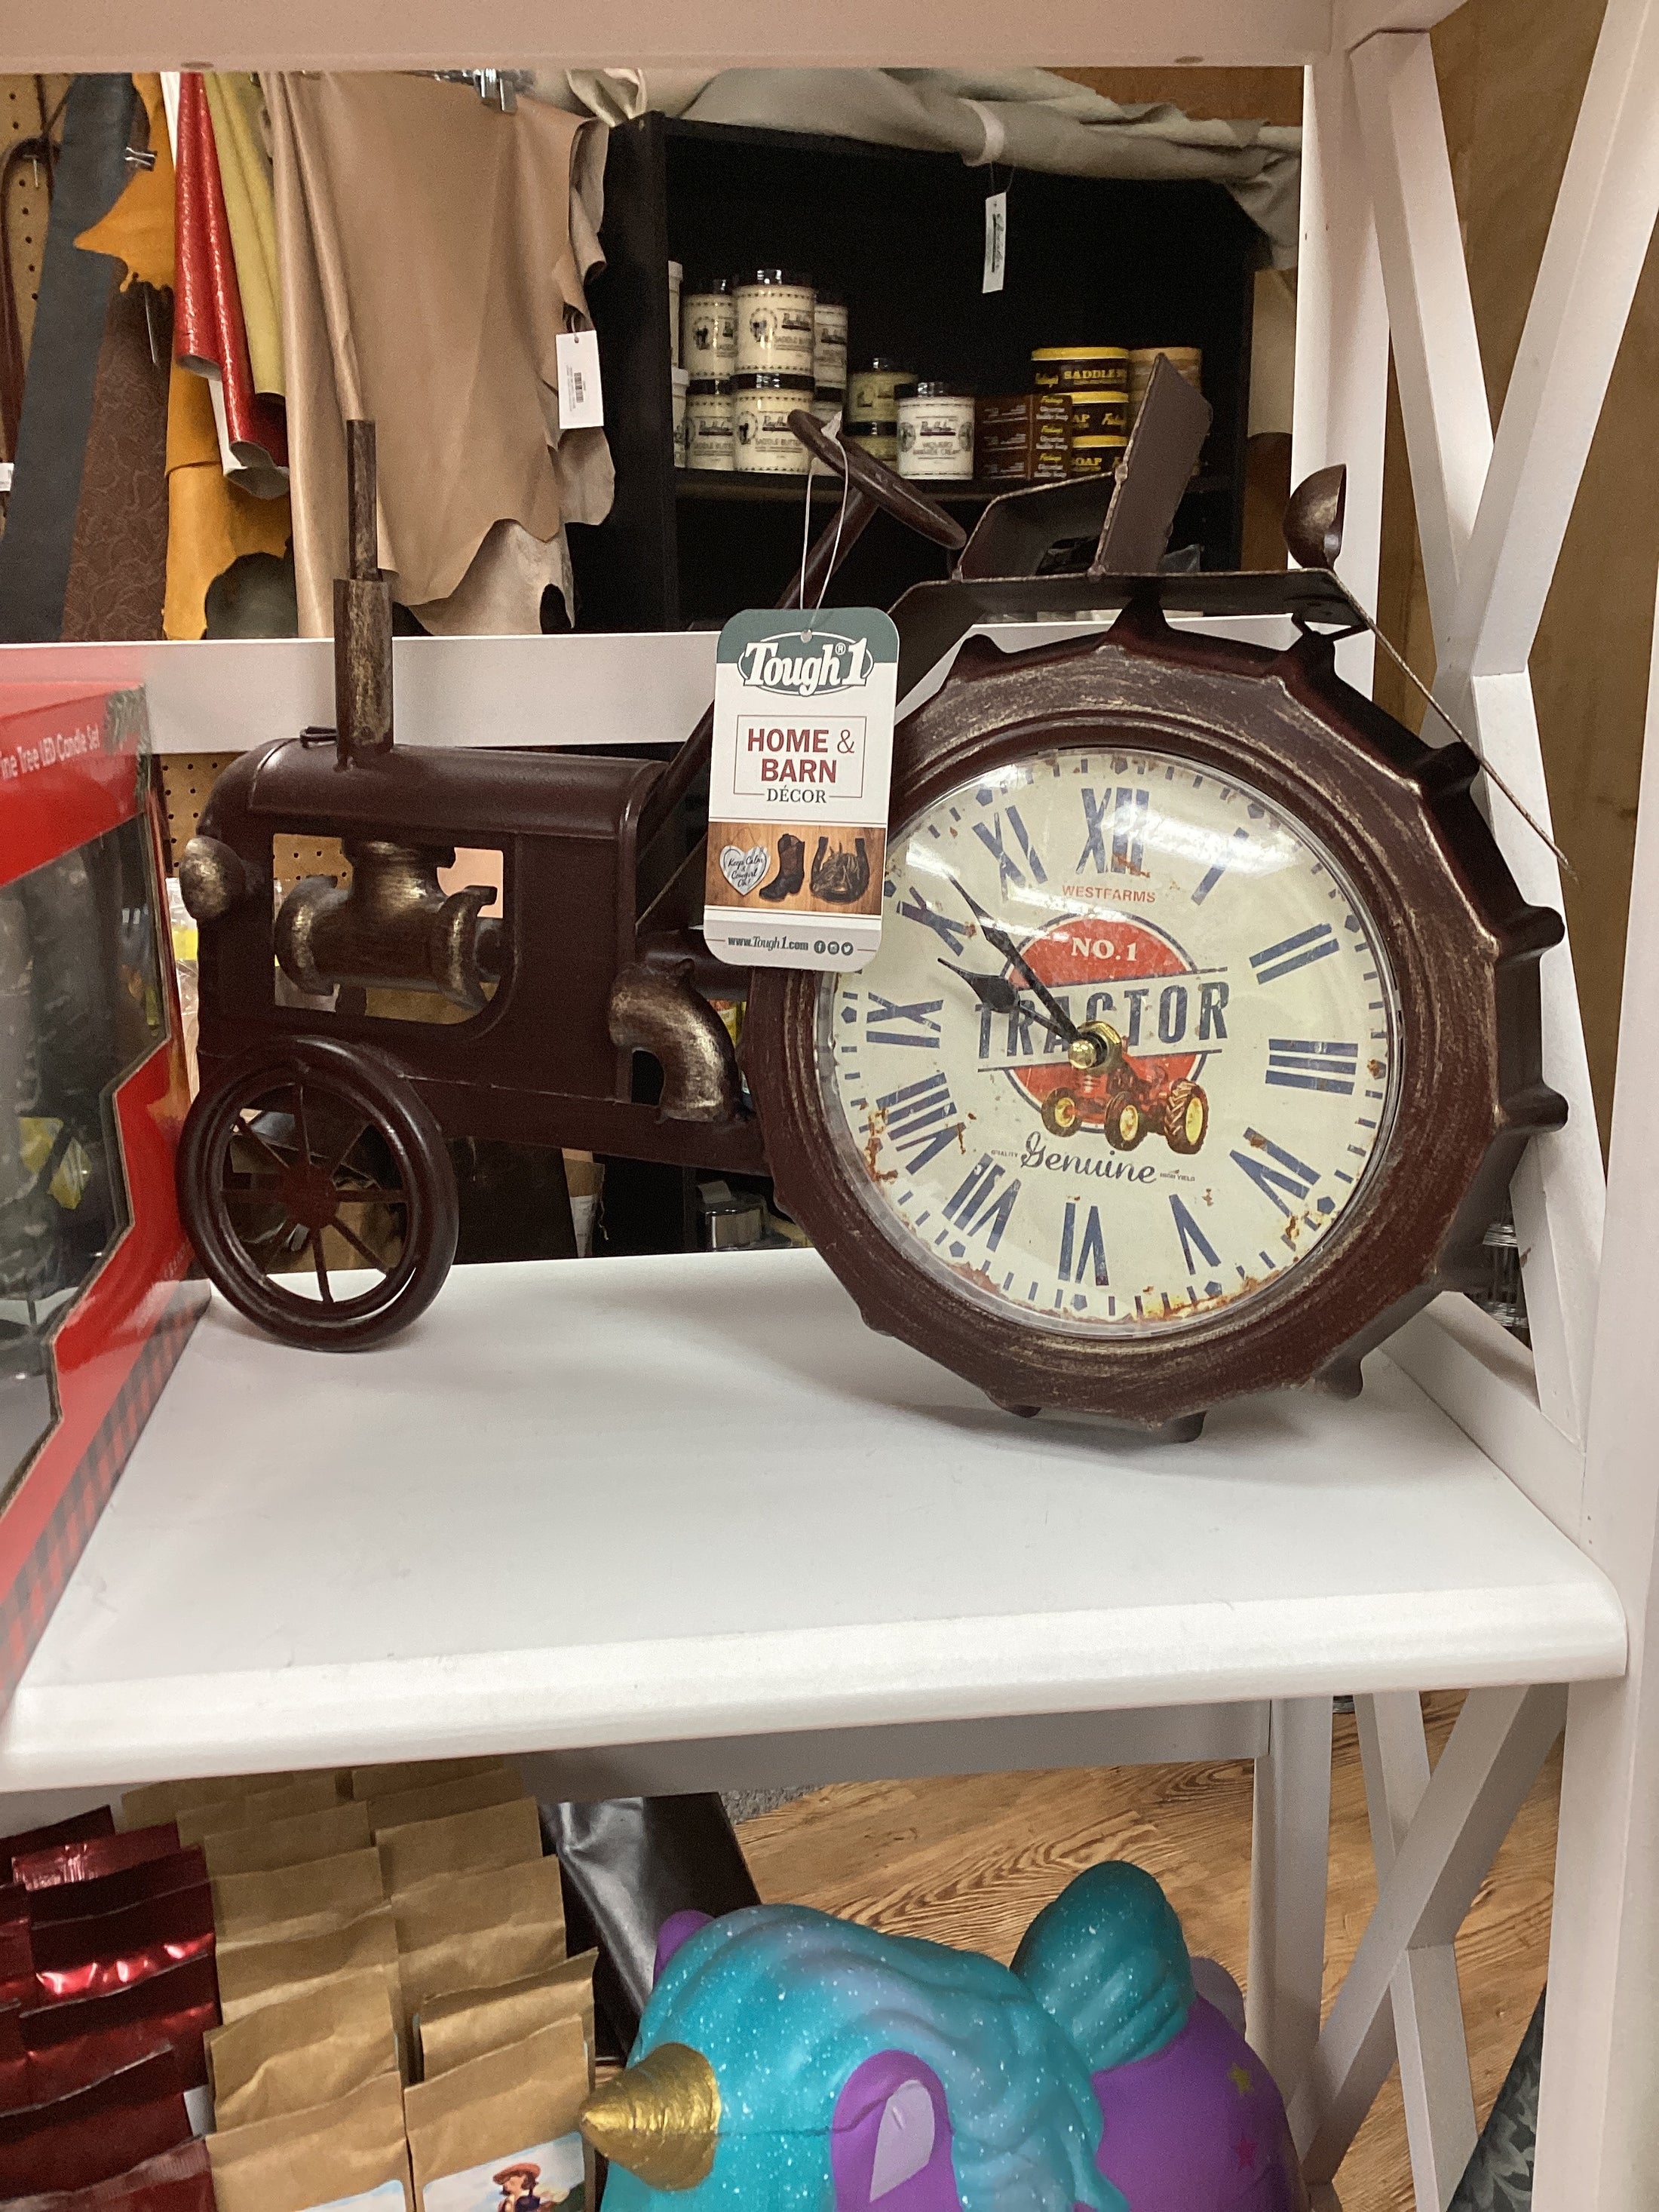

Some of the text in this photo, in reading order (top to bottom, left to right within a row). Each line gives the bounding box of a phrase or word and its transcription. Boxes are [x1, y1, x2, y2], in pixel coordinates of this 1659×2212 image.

[57, 727, 87, 762] Candle
[747, 729, 855, 754] HOME &
[761, 758, 837, 784] BARN
[766, 784, 827, 804] DÉCOR
[972, 805, 1048, 902] XI
[1075, 787, 1150, 876] XII
[897, 886, 977, 956] X
[1063, 885, 1156, 904] WESTFARMS
[728, 936, 809, 952] www.Tough1.com
[1249, 922, 1340, 985] II
[866, 992, 944, 1050] IX
[1265, 1038, 1358, 1095] III
[875, 1072, 967, 1175] VIII
[1020, 1131, 1158, 1184] Genuine
[1229, 1127, 1321, 1217] IV
[941, 1152, 1022, 1253] VII
[1057, 1202, 1109, 1287] VI
[1169, 1194, 1222, 1275] V
